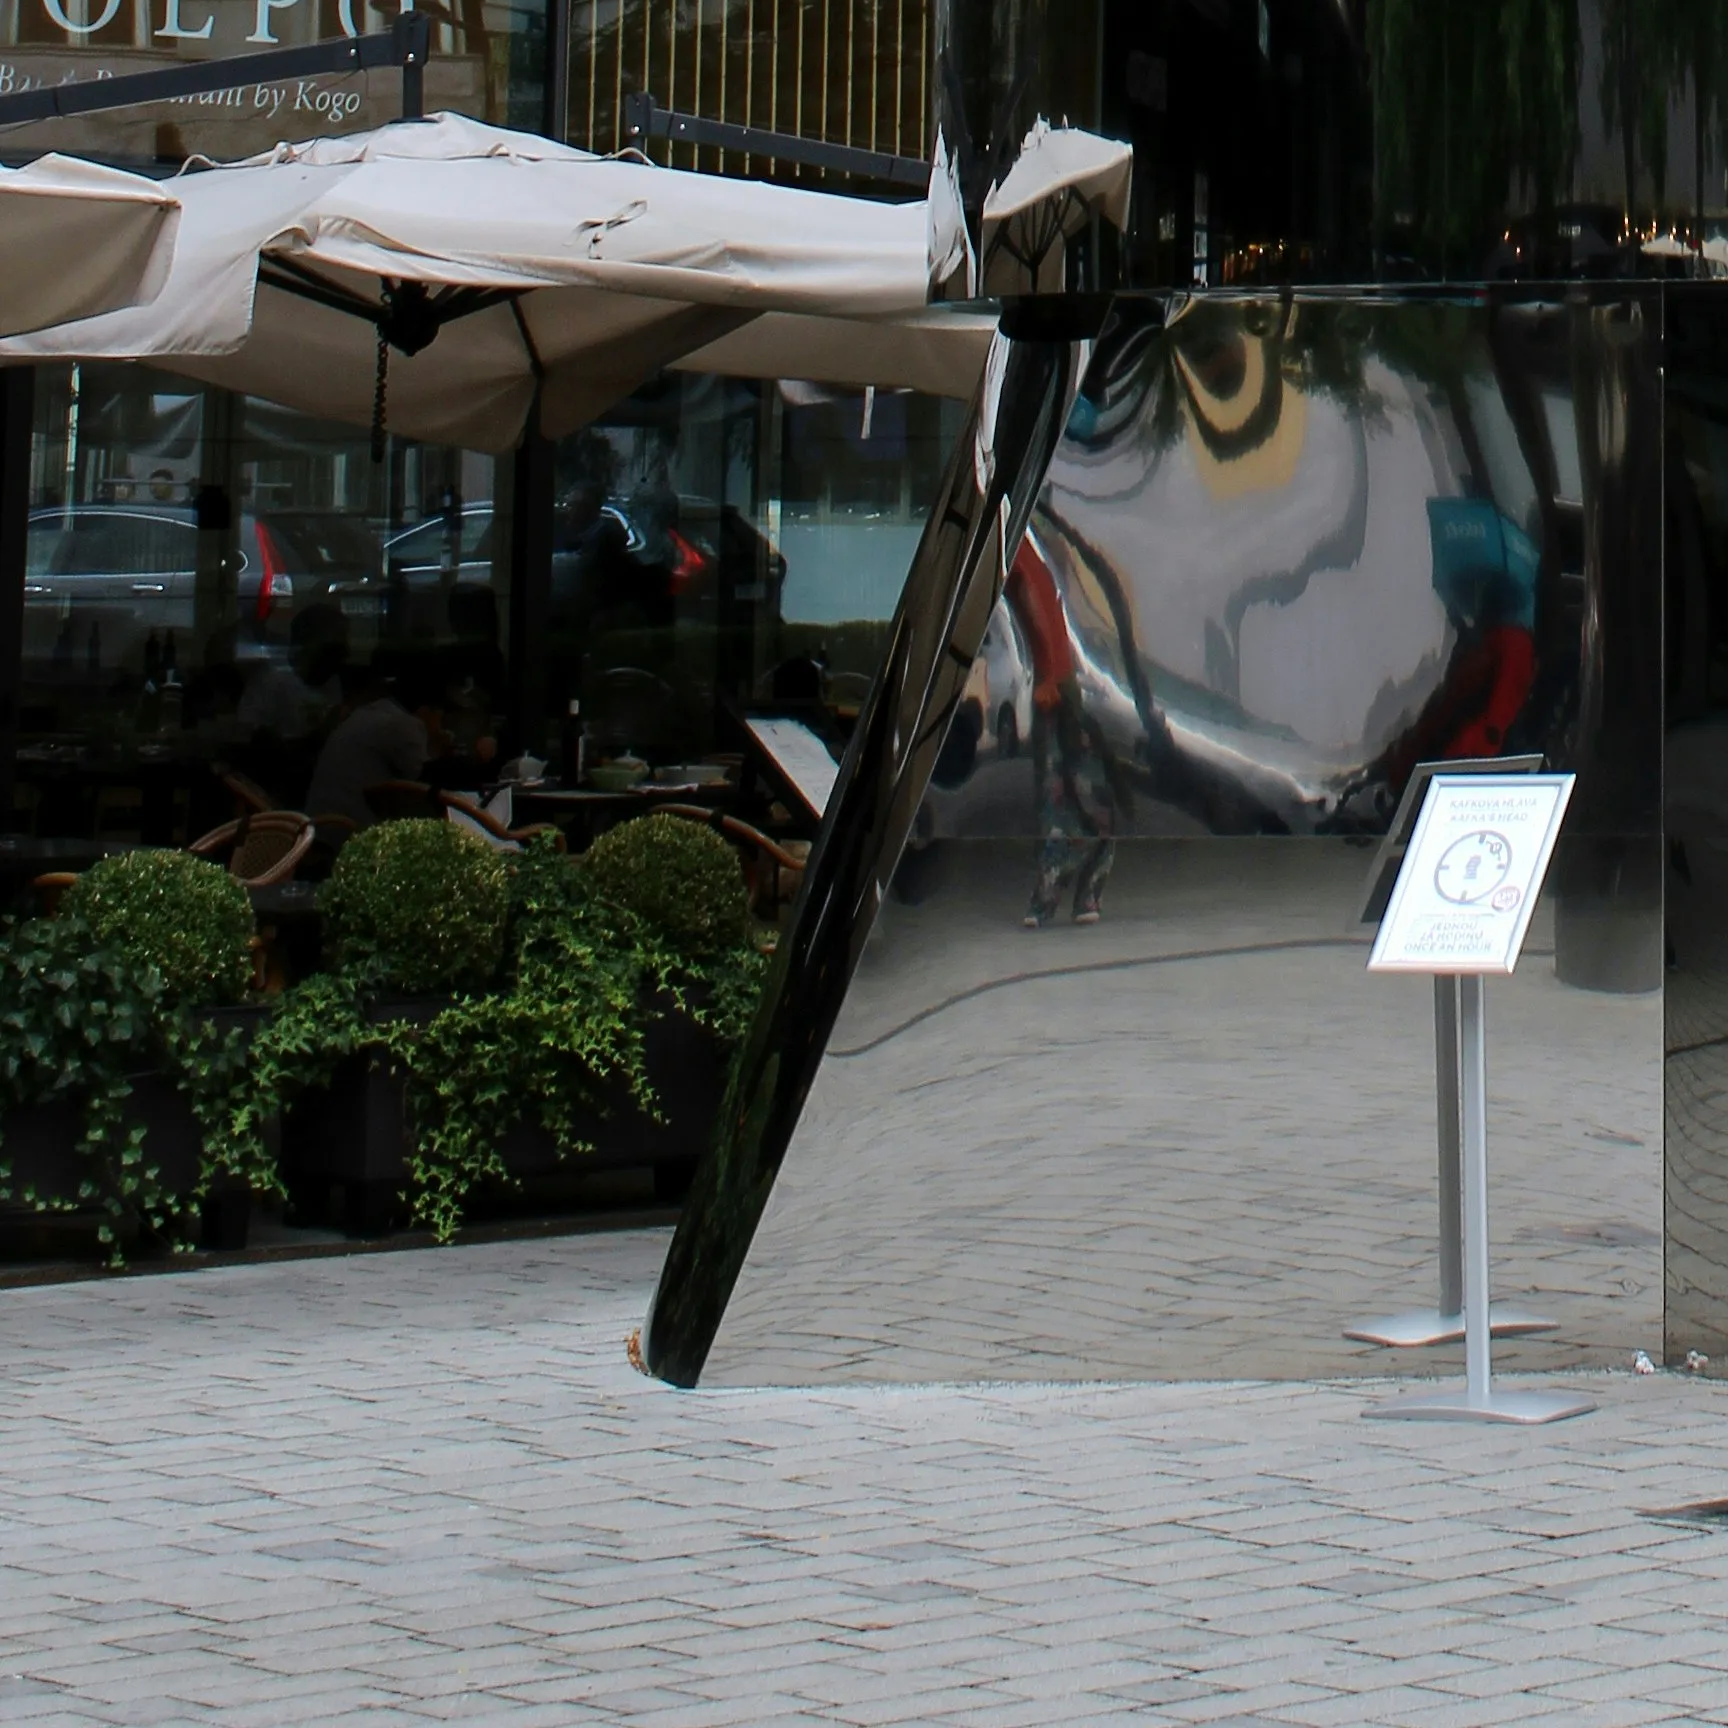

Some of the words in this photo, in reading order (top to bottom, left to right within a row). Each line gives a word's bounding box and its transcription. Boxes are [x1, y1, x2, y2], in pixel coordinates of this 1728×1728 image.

[254, 84, 285, 119] by
[293, 81, 361, 123] Kogo
[1450, 798, 1500, 809] KAFKOVA
[1502, 797, 1537, 808] HLAVA
[1450, 812, 1496, 823] KAFKA'S
[1498, 812, 1528, 823] HEAD
[1404, 942, 1435, 953] ONCE
[1438, 942, 1455, 953] AN
[1457, 942, 1492, 953] HOUR
